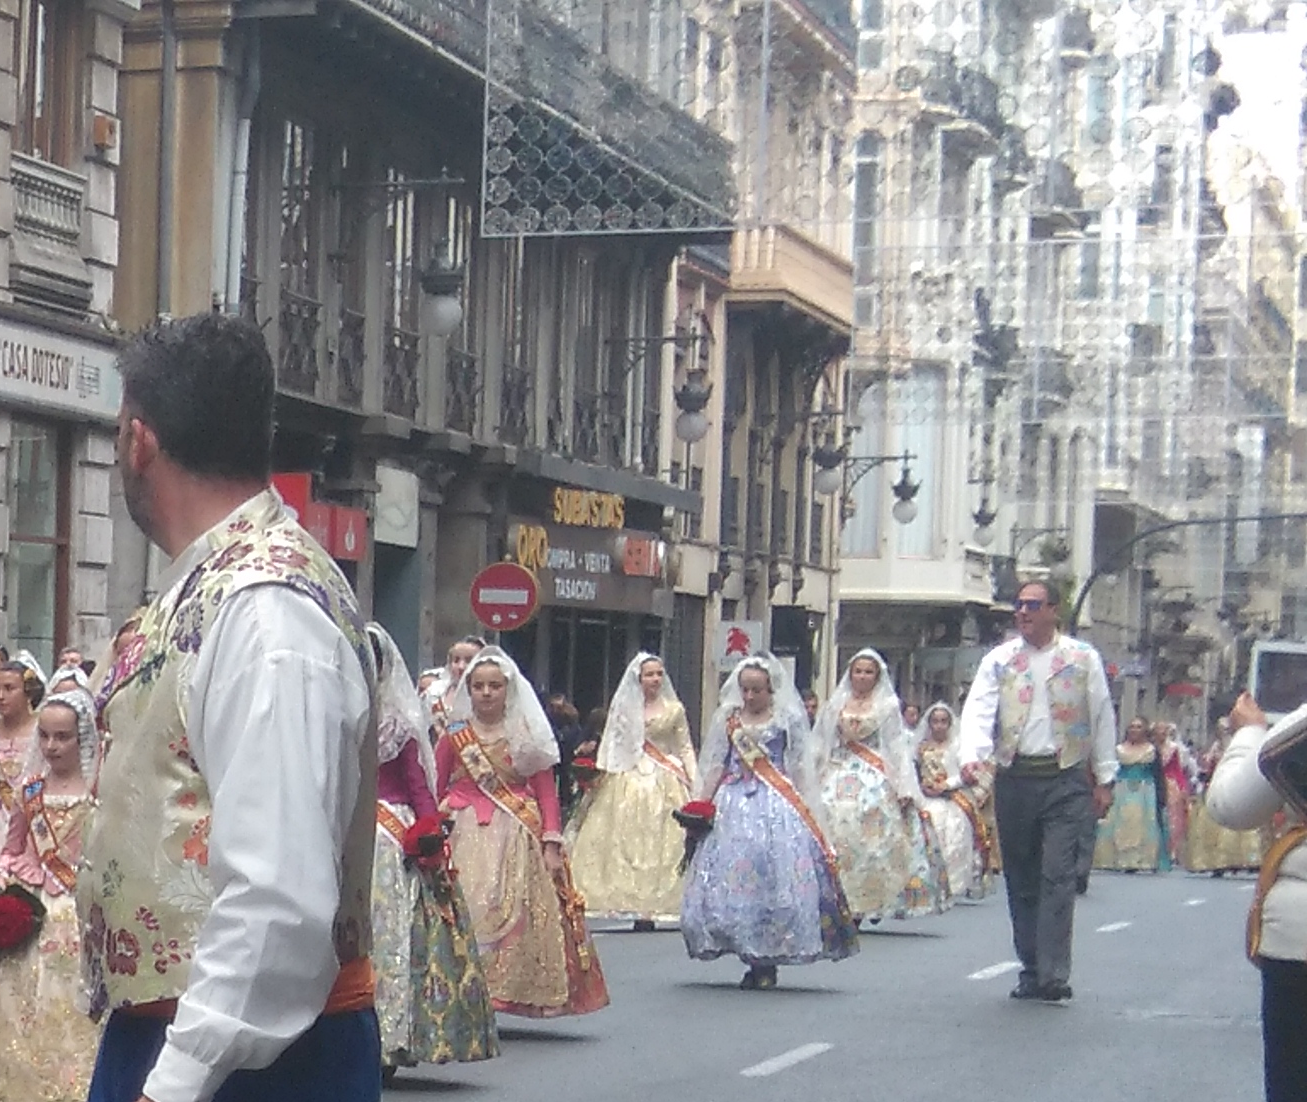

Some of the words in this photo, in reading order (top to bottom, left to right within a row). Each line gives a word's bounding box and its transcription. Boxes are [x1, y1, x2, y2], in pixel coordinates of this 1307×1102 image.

[553, 487, 626, 530] SUBASTAS
[517, 524, 549, 571] ORO
[584, 552, 612, 574] VENTA
